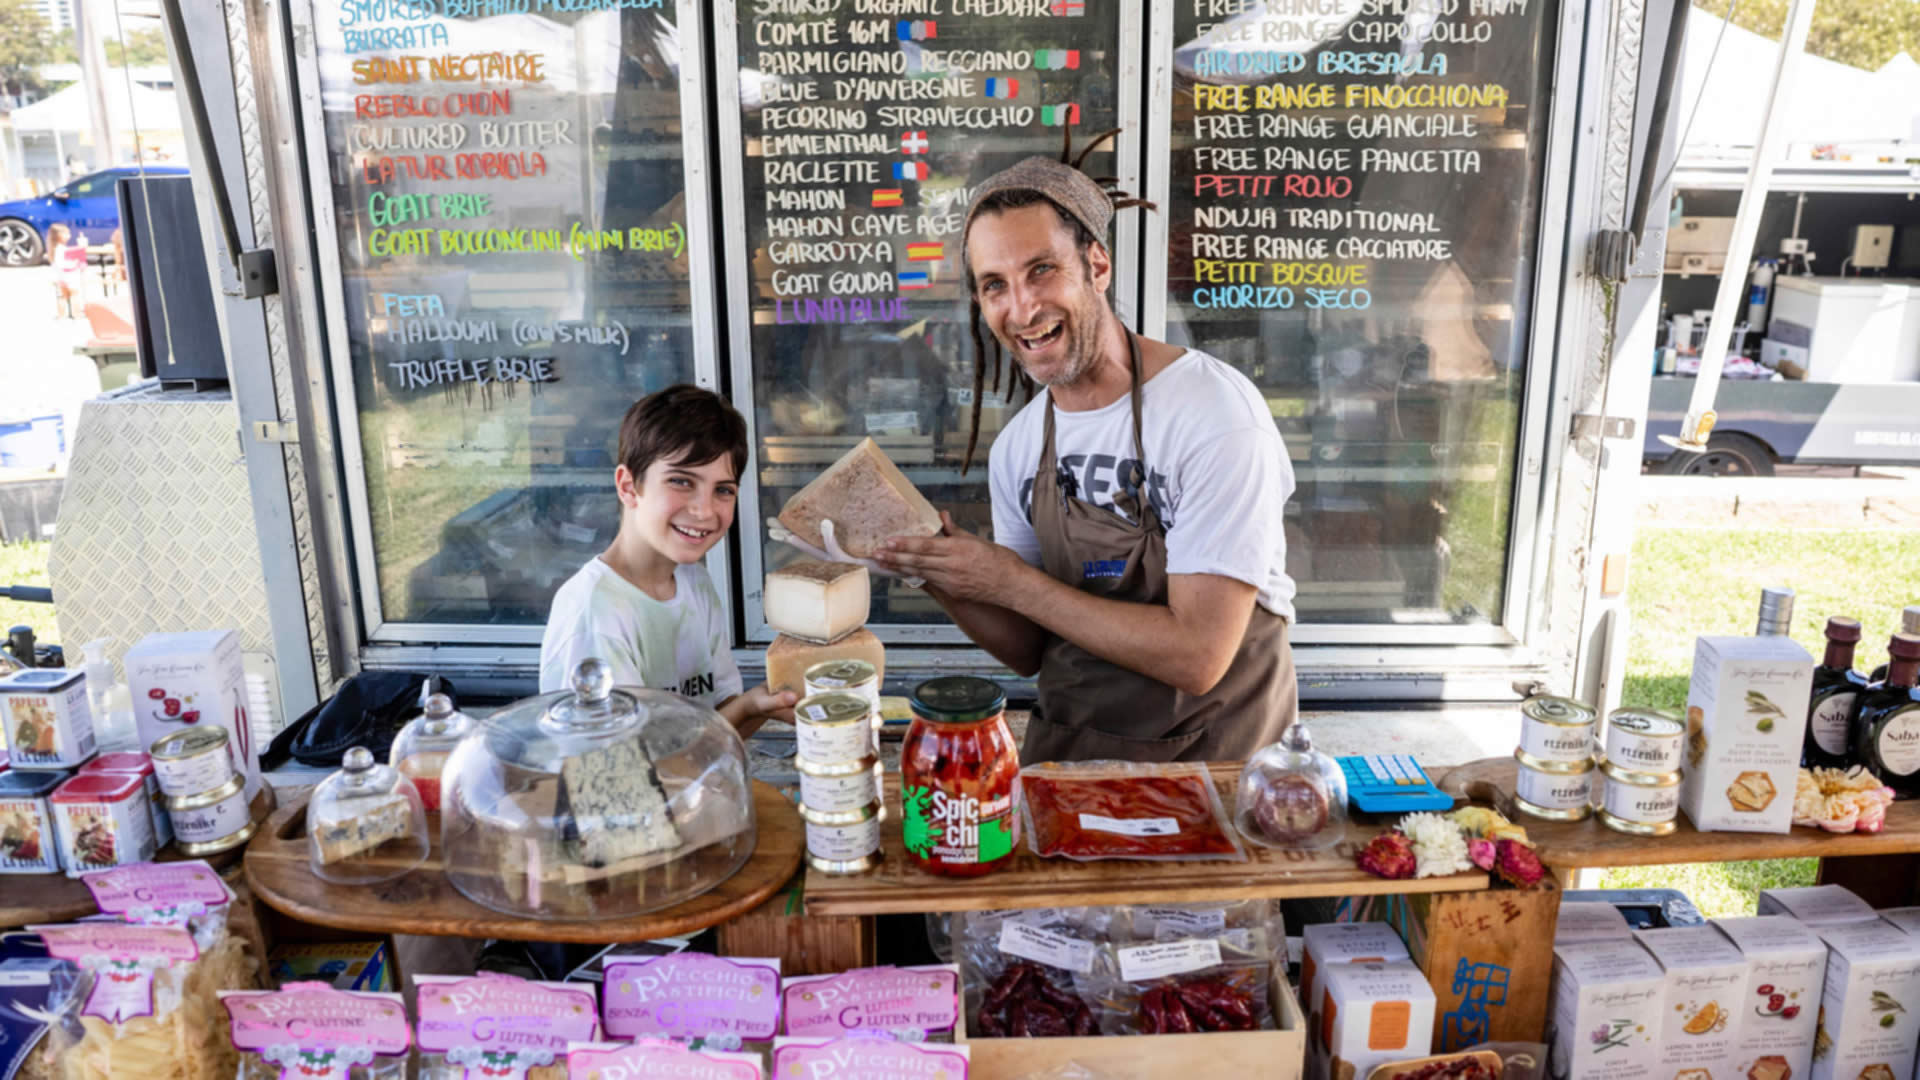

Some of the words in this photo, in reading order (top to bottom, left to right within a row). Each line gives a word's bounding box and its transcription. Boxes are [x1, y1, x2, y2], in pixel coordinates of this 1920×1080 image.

[339, 0, 435, 26] SMOKED
[1193, 0, 1253, 17] FREE
[344, 22, 449, 53] BURRATA
[847, 19, 890, 45] 16M
[1196, 22, 1253, 43] FREE
[1262, 21, 1343, 43] RANGE
[1348, 20, 1492, 43] CAPOCOLLO
[351, 55, 427, 86] SAINT
[429, 52, 545, 84] NECTAIRE
[758, 50, 907, 75] PARMIGIANO
[920, 50, 1032, 74] REGGIANO
[1193, 53, 1233, 76] AIR
[1238, 52, 1306, 75] DRIED
[1317, 52, 1447, 76] BRESAOLA
[759, 80, 820, 102] BLUE
[835, 77, 977, 101] D'AUVERGNE
[1193, 84, 1251, 110] FREE
[1255, 83, 1336, 109] RANGE
[1345, 84, 1509, 109] FINOCCHIONA
[355, 89, 511, 119] REBLOCHON
[761, 107, 868, 130] PECORINO
[876, 105, 1034, 128] STRAVECCHIO
[1193, 115, 1253, 140] FREE
[1259, 114, 1336, 138] RANGE
[1347, 114, 1479, 139] GUANCIALE
[352, 122, 466, 150] CULTURED
[480, 119, 573, 148] BUTTER
[761, 134, 898, 157] EMMENTHAL
[363, 156, 396, 186] LA
[394, 155, 452, 182] TUR
[456, 151, 547, 181] ROBIOLA
[764, 161, 880, 184] RACLETTE
[1194, 147, 1257, 171] FREE
[1264, 147, 1350, 171] RANGE
[1360, 148, 1481, 173] PANCETTA
[1194, 175, 1278, 197] PETIT
[1283, 175, 1353, 197] ROJO
[368, 191, 433, 226] GOAT
[439, 192, 492, 219] BRIE
[765, 188, 845, 211] MAHON
[766, 216, 844, 238] MAHON
[851, 214, 912, 235] CAVE
[916, 212, 965, 236] AGE
[1194, 207, 1277, 229] NDUJA
[1284, 209, 1441, 233] TRADITIONAL
[368, 228, 434, 257] GOAT
[440, 229, 561, 256] BOCCONCINI
[569, 222, 624, 261] (MINI
[629, 222, 685, 259] BRIE)
[768, 241, 893, 265] GARROTXA
[1192, 234, 1248, 258] FREE
[1254, 236, 1329, 259] RANGE
[1335, 238, 1452, 261] CACCIATORE
[771, 269, 822, 296] GOAT
[828, 271, 894, 295] GOUDA
[1193, 259, 1265, 284] PETIT
[1271, 263, 1368, 286] BOSQUE
[381, 293, 445, 317] FETA
[1193, 284, 1294, 309] CHORIZO
[1304, 287, 1372, 309] SECO
[775, 297, 845, 325] LUNA
[850, 297, 913, 324] BLUE
[387, 318, 498, 345] HALLOUMI
[574, 320, 630, 355] MILK)
[388, 357, 489, 390] TRUFFLE
[494, 357, 553, 381] BRIE
[932, 790, 979, 824] Spic
[946, 819, 979, 847] chi
[655, 964, 753, 986] VECCHIO
[634, 976, 759, 1003] PASTIFICIO
[831, 1048, 940, 1073] VECCHIO
